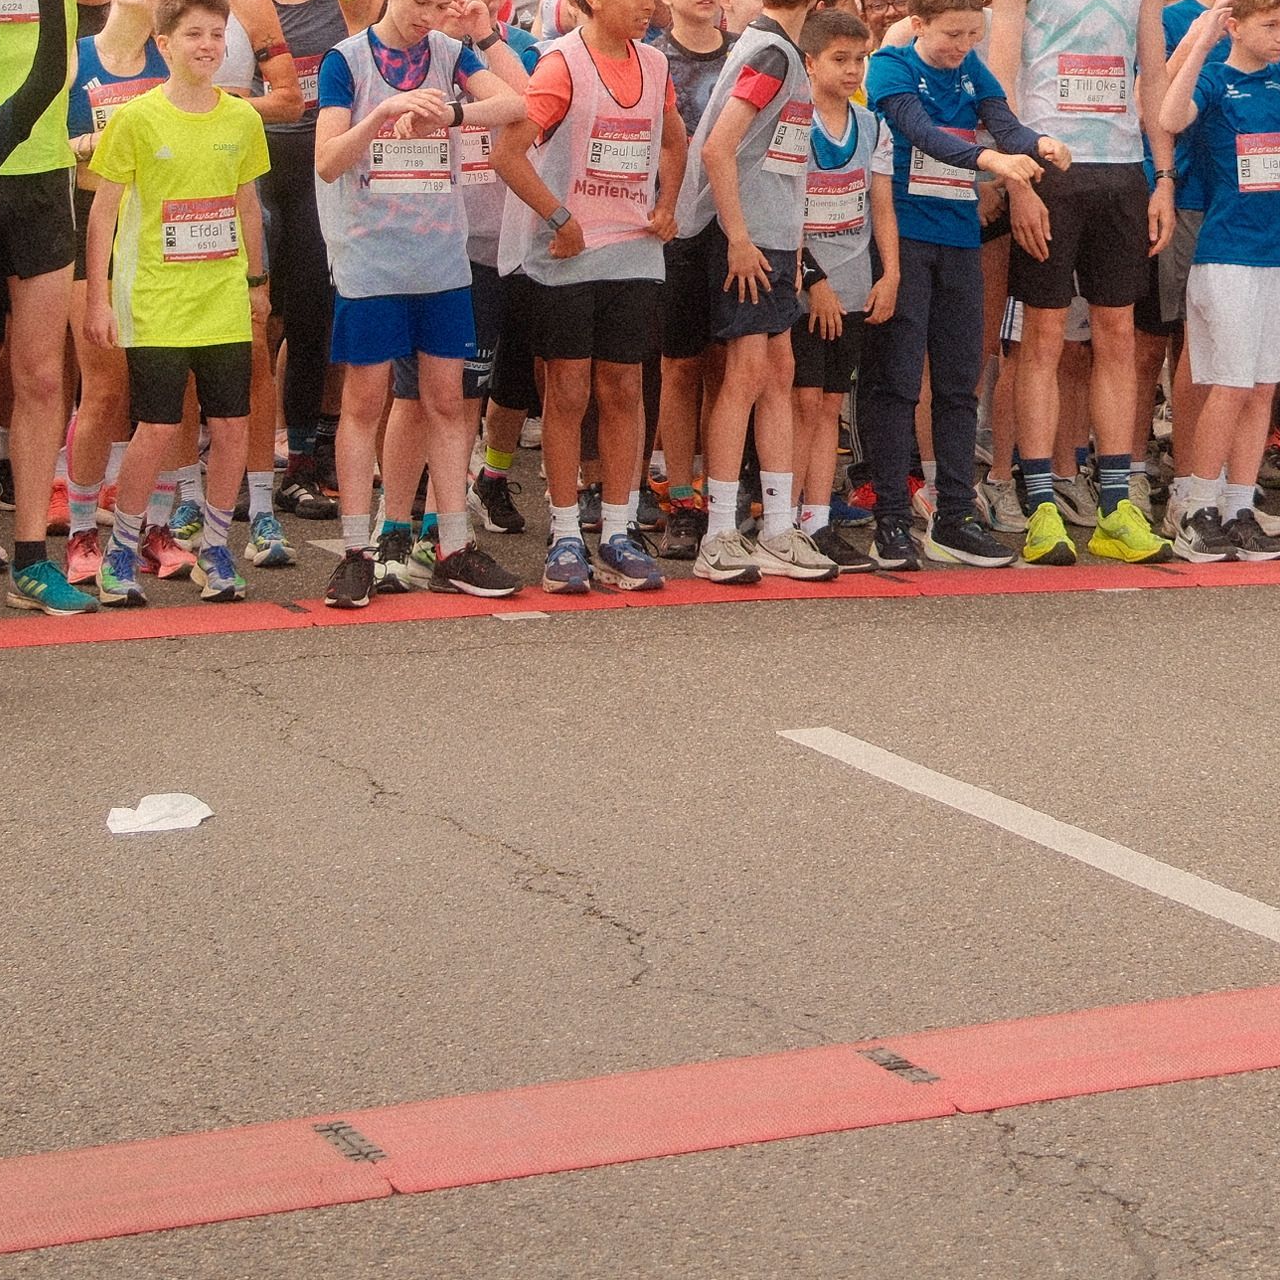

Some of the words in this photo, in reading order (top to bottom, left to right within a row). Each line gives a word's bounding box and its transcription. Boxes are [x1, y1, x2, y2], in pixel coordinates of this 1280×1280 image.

[1, 2, 23, 11] 6224
[1075, 79, 1093, 91] Till
[1095, 79, 1117, 91] Oke
[384, 143, 439, 155] Constantin
[603, 144, 629, 157] Paul
[404, 159, 424, 167] 7189
[620, 161, 638, 170] 7215
[466, 172, 489, 182] 7195
[422, 181, 444, 192] 7189
[190, 224, 223, 238] Efdal
